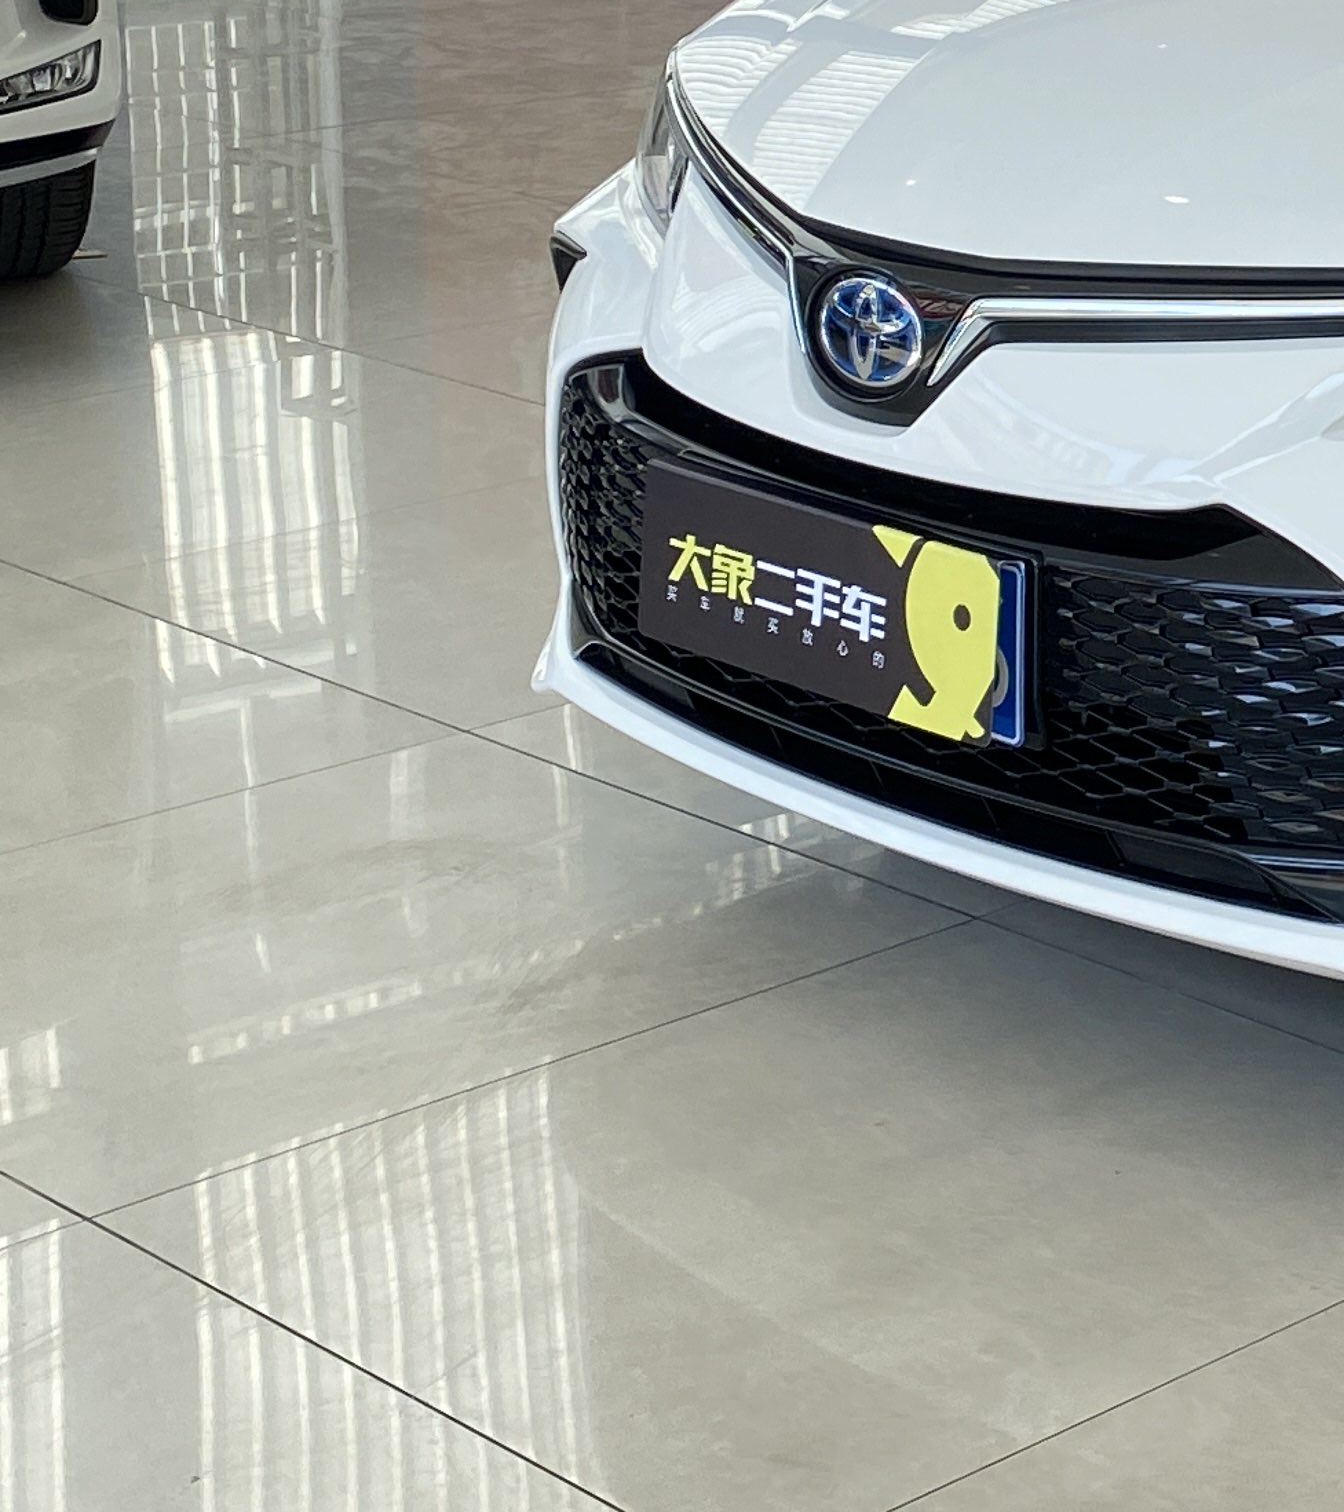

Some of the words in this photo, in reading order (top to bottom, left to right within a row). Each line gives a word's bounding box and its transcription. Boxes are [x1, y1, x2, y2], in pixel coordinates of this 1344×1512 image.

[669, 534, 887, 642] 大象二手车
